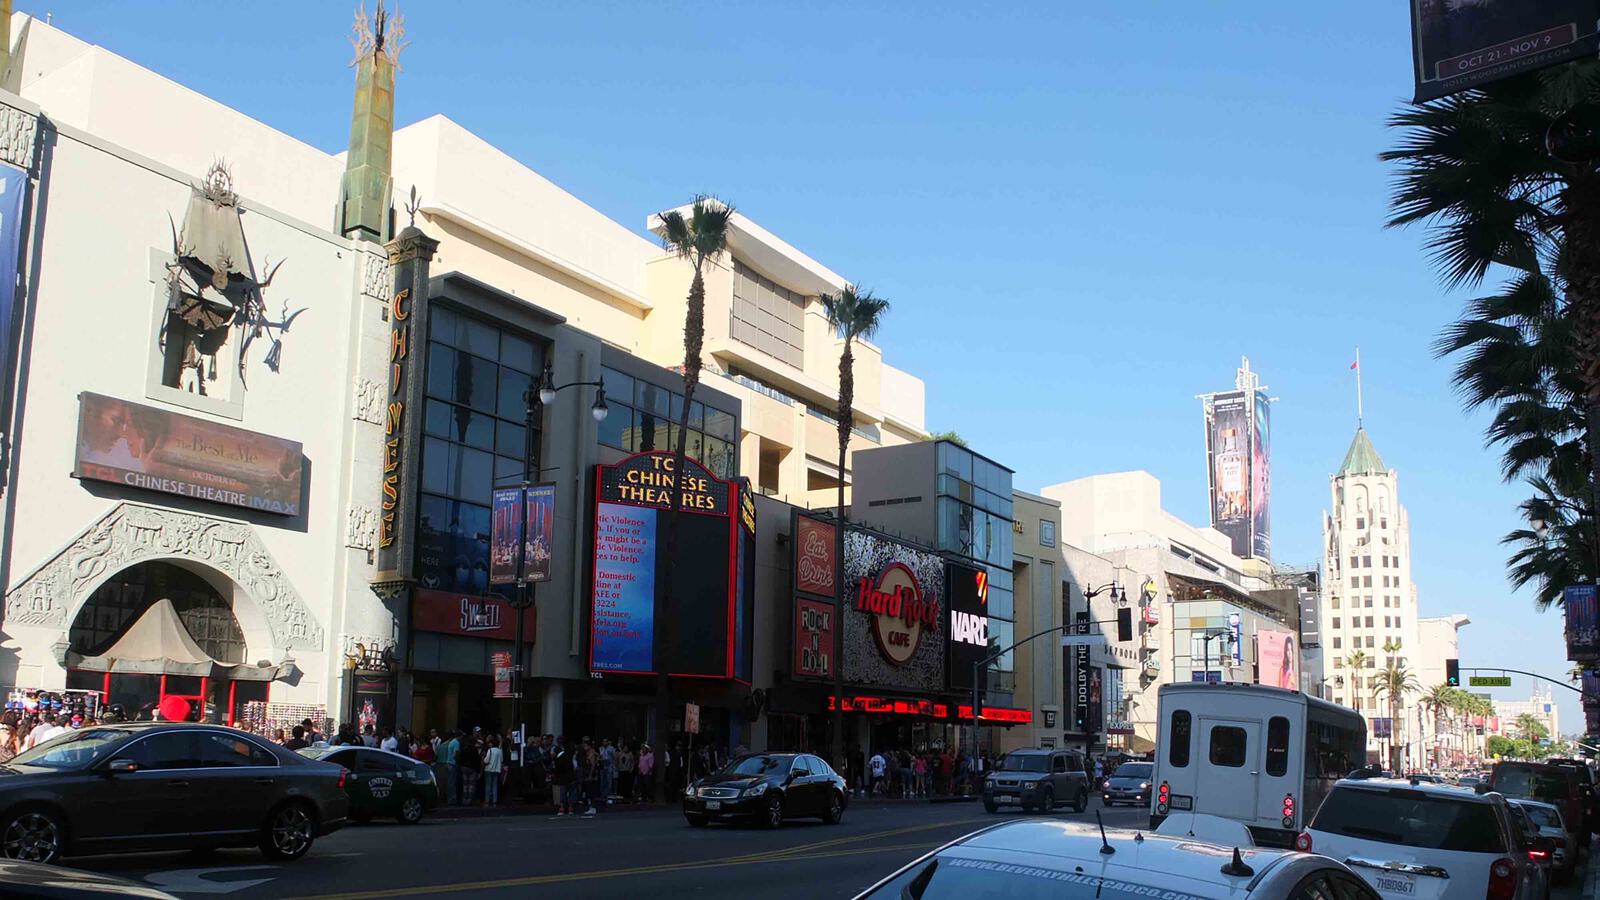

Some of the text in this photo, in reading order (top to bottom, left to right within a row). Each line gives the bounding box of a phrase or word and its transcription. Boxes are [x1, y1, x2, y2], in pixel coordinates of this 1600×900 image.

[1458, 55, 1482, 70] OCT
[1488, 50, 1500, 61] 21
[1510, 39, 1539, 56] NOV
[1544, 35, 1552, 45] 9
[380, 288, 410, 549] CHINESE
[192, 434, 225, 458] Best
[238, 446, 258, 464] Me
[651, 455, 676, 472] TC
[124, 471, 186, 496] CHINESE
[188, 484, 246, 506] THEATRE
[249, 495, 297, 514] IMAX
[618, 485, 716, 510] THEARES
[605, 535, 629, 544] might
[599, 571, 637, 581] Domestic
[800, 556, 833, 587] Drink
[858, 576, 939, 631] Hard Rock
[802, 608, 829, 632] ROCK
[888, 631, 910, 647] CAFE
[1078, 619, 1087, 666] THERE
[1104, 644, 1137, 660] SEPHORA
[368, 777, 393, 787] UNITED
